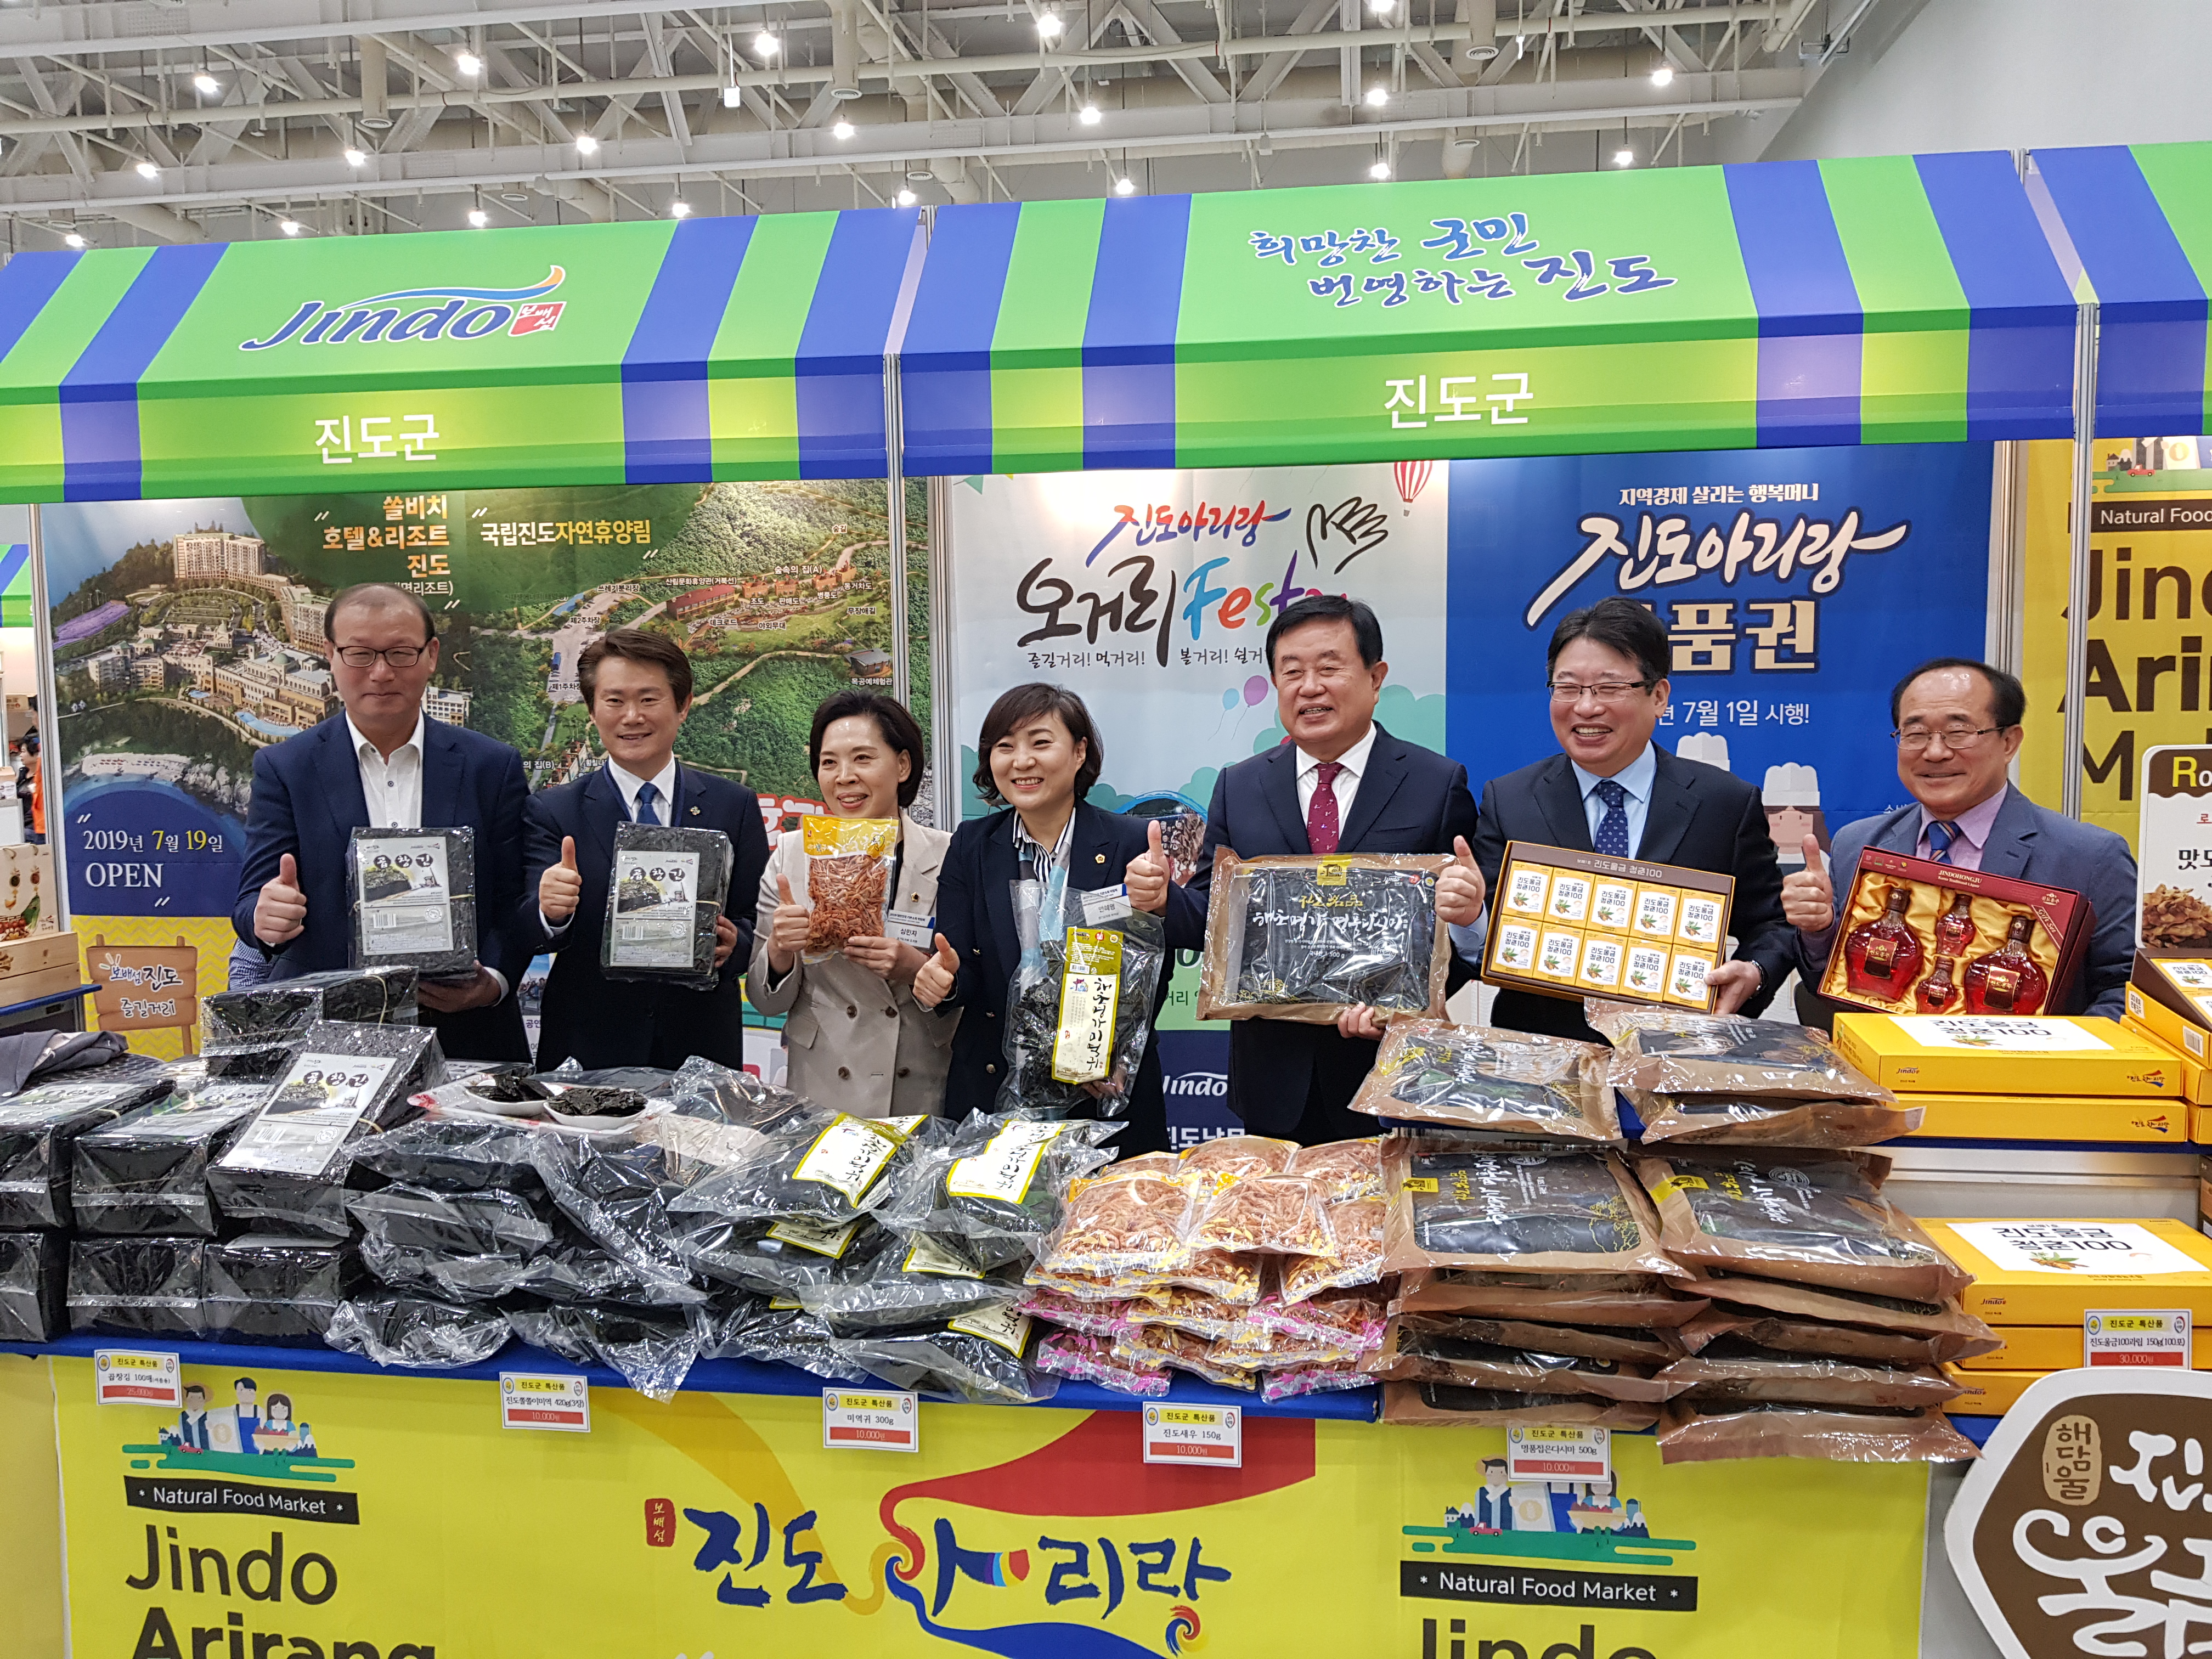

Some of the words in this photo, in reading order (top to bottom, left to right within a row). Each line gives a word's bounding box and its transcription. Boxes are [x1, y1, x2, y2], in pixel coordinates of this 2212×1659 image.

[1251, 229, 1400, 266] 희망찬
[1423, 214, 1538, 259] 군민
[1310, 269, 1514, 306] 번영하는
[1525, 251, 1677, 300] 진도
[239, 300, 512, 350] Jindo
[1384, 373, 1534, 429] 진도군
[314, 414, 440, 464] 진도군
[1620, 487, 1688, 506] 지역경제
[1691, 484, 1745, 505] 살리는
[1748, 482, 1819, 504] 행복머니
[382, 495, 448, 520] 쏠비치
[2101, 510, 2165, 525] Natural
[479, 520, 652, 546] 국립진도자연휴양림
[832, 524, 848, 534] 숲길
[1086, 500, 1291, 567] 진도아리랑
[323, 524, 451, 550] 호텔&리조트
[408, 553, 451, 578] 진도
[774, 565, 798, 574] 숲속의
[802, 564, 822, 575] 집(A)
[1527, 511, 1908, 627] 진도아리랑
[597, 584, 639, 593] 쓰레기분리장
[844, 583, 872, 591] 동거차도
[750, 597, 765, 606] 조도
[778, 597, 800, 606] 판매도
[817, 591, 838, 600] 병풍도
[847, 606, 877, 616] 무장애길
[1016, 555, 1177, 668] 오거리
[1182, 550, 1347, 641] Fest
[570, 616, 600, 625] 제2주차장
[709, 618, 737, 627] 데크로드
[758, 621, 787, 630] 야외무대
[1649, 599, 1815, 670] 품권
[1028, 653, 1091, 668] 즐길거리!
[1097, 652, 1146, 667] 먹거리!
[1181, 647, 1228, 665] 볼거리!
[1234, 646, 1268, 665] 쉴거
[851, 677, 893, 686] 목공예체험관
[1683, 702, 1719, 727] 7월
[1726, 699, 1758, 726] 1일
[1765, 703, 1810, 725] 시행!
[534, 760, 554, 769] 집(B)
[83, 830, 144, 854] 2019년
[152, 830, 179, 854] 7월
[186, 830, 224, 853] 19일
[85, 863, 163, 888] OPEN
[1594, 859, 1627, 872] 진도울금
[1629, 865, 1662, 878] 청춘100
[1939, 870, 1982, 884] JINDOHONGJU
[111, 967, 142, 984] 보배섬
[143, 965, 182, 991] 진도
[121, 999, 176, 1016] 즐길거리
[1992, 1227, 2114, 1238] 진도울금
[2009, 1240, 2133, 1251] 청춘100
[2110, 1320, 2134, 1328] 진도군
[2138, 1319, 2163, 1328] 특산품
[117, 1358, 137, 1366] 진도군
[545, 1383, 565, 1391] 특산품
[847, 1398, 867, 1406] 진도군
[872, 1399, 893, 1408] 특산품
[847, 1414, 871, 1424] 미역귀
[875, 1415, 894, 1425] 300g
[1166, 1412, 1188, 1421] 진도군
[1193, 1413, 1216, 1422] 특산품
[1163, 1429, 1197, 1438] 진도새우
[1202, 1430, 1221, 1441] 150g
[1532, 1430, 1555, 1438] 진도군
[1560, 1430, 1584, 1438] 특산품
[1578, 1446, 1597, 1455] 500g
[153, 1487, 217, 1505] Natural
[223, 1489, 265, 1508] Food
[269, 1494, 327, 1515] Market
[125, 1524, 337, 1606] Jindo
[1439, 1572, 1515, 1596] Natural
[1522, 1577, 1576, 1598] Food
[1583, 1581, 1657, 1601] Market
